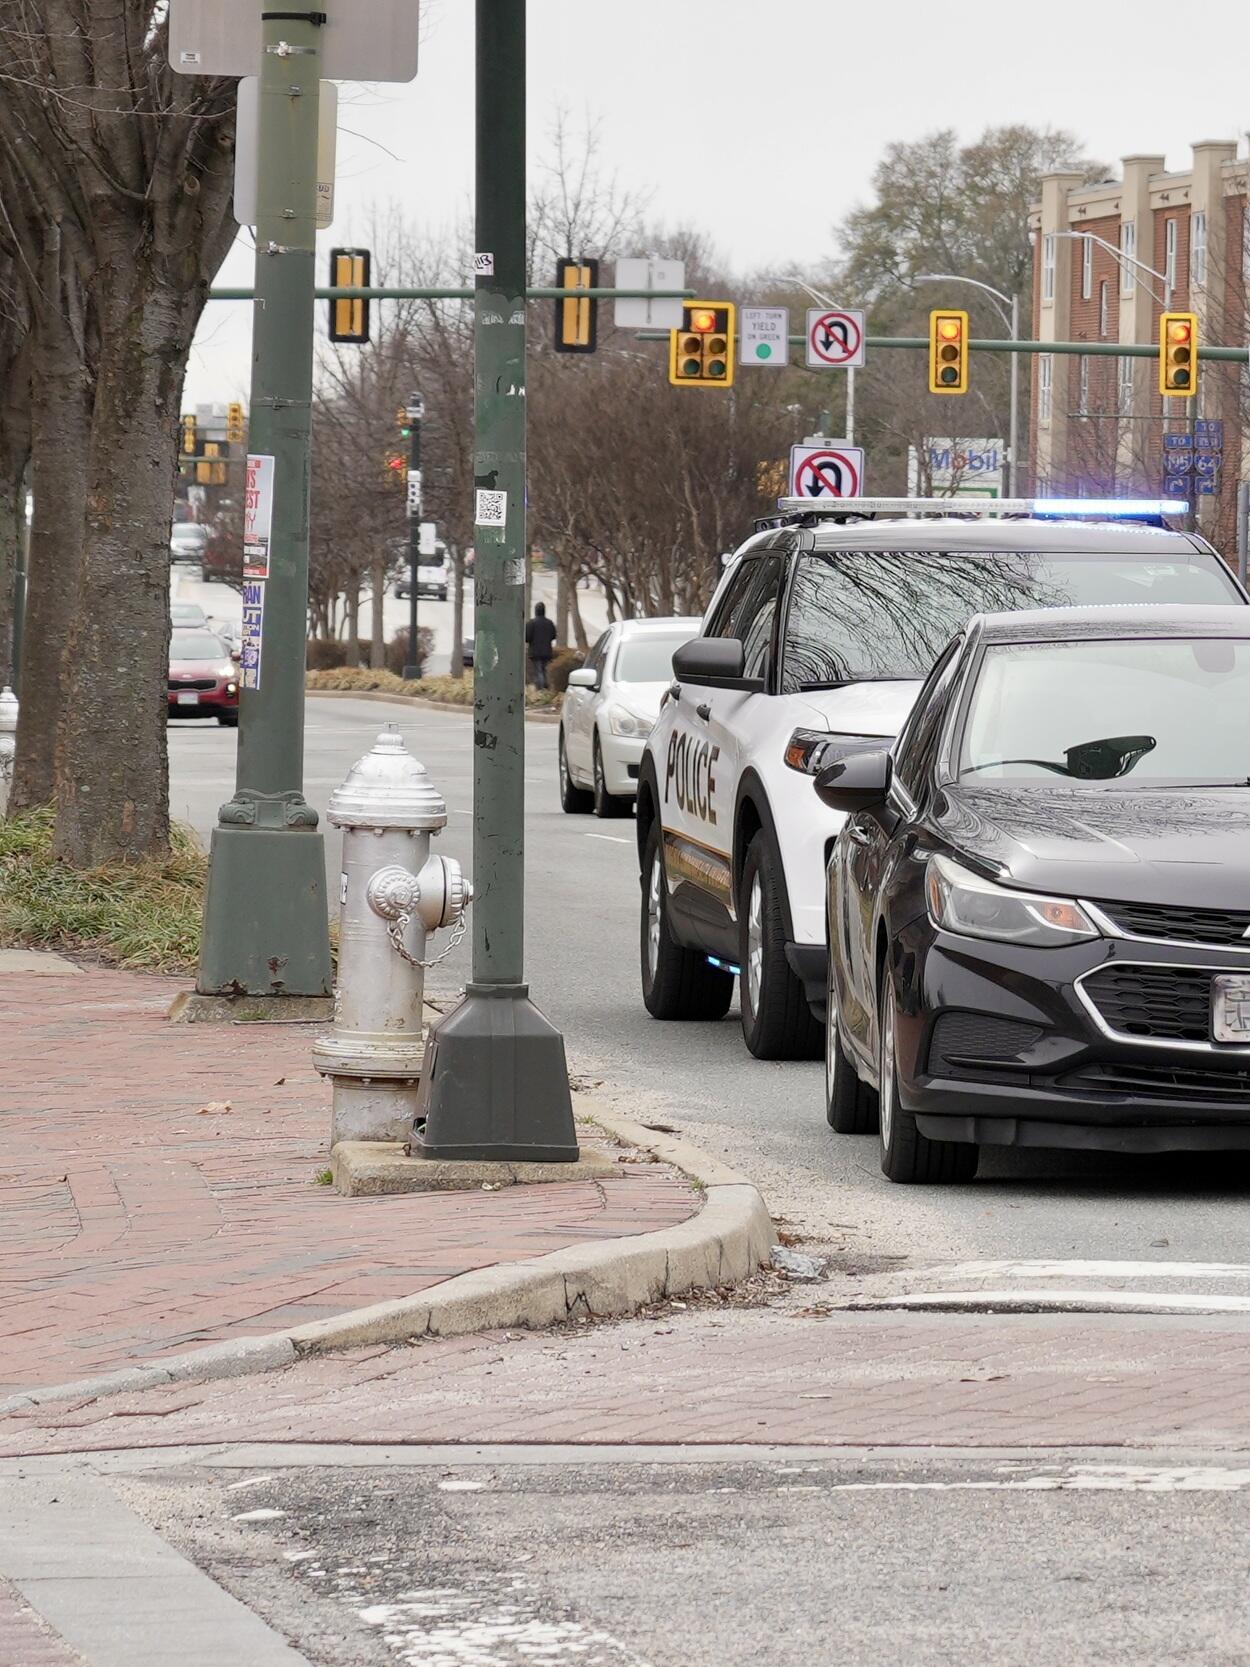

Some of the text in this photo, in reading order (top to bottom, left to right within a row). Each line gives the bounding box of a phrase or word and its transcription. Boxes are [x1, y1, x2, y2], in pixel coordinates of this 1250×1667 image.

[752, 322, 777, 331] YIELD
[930, 448, 997, 471] Mobil
[1198, 457, 1215, 471] 64
[665, 729, 720, 825] POLICE
